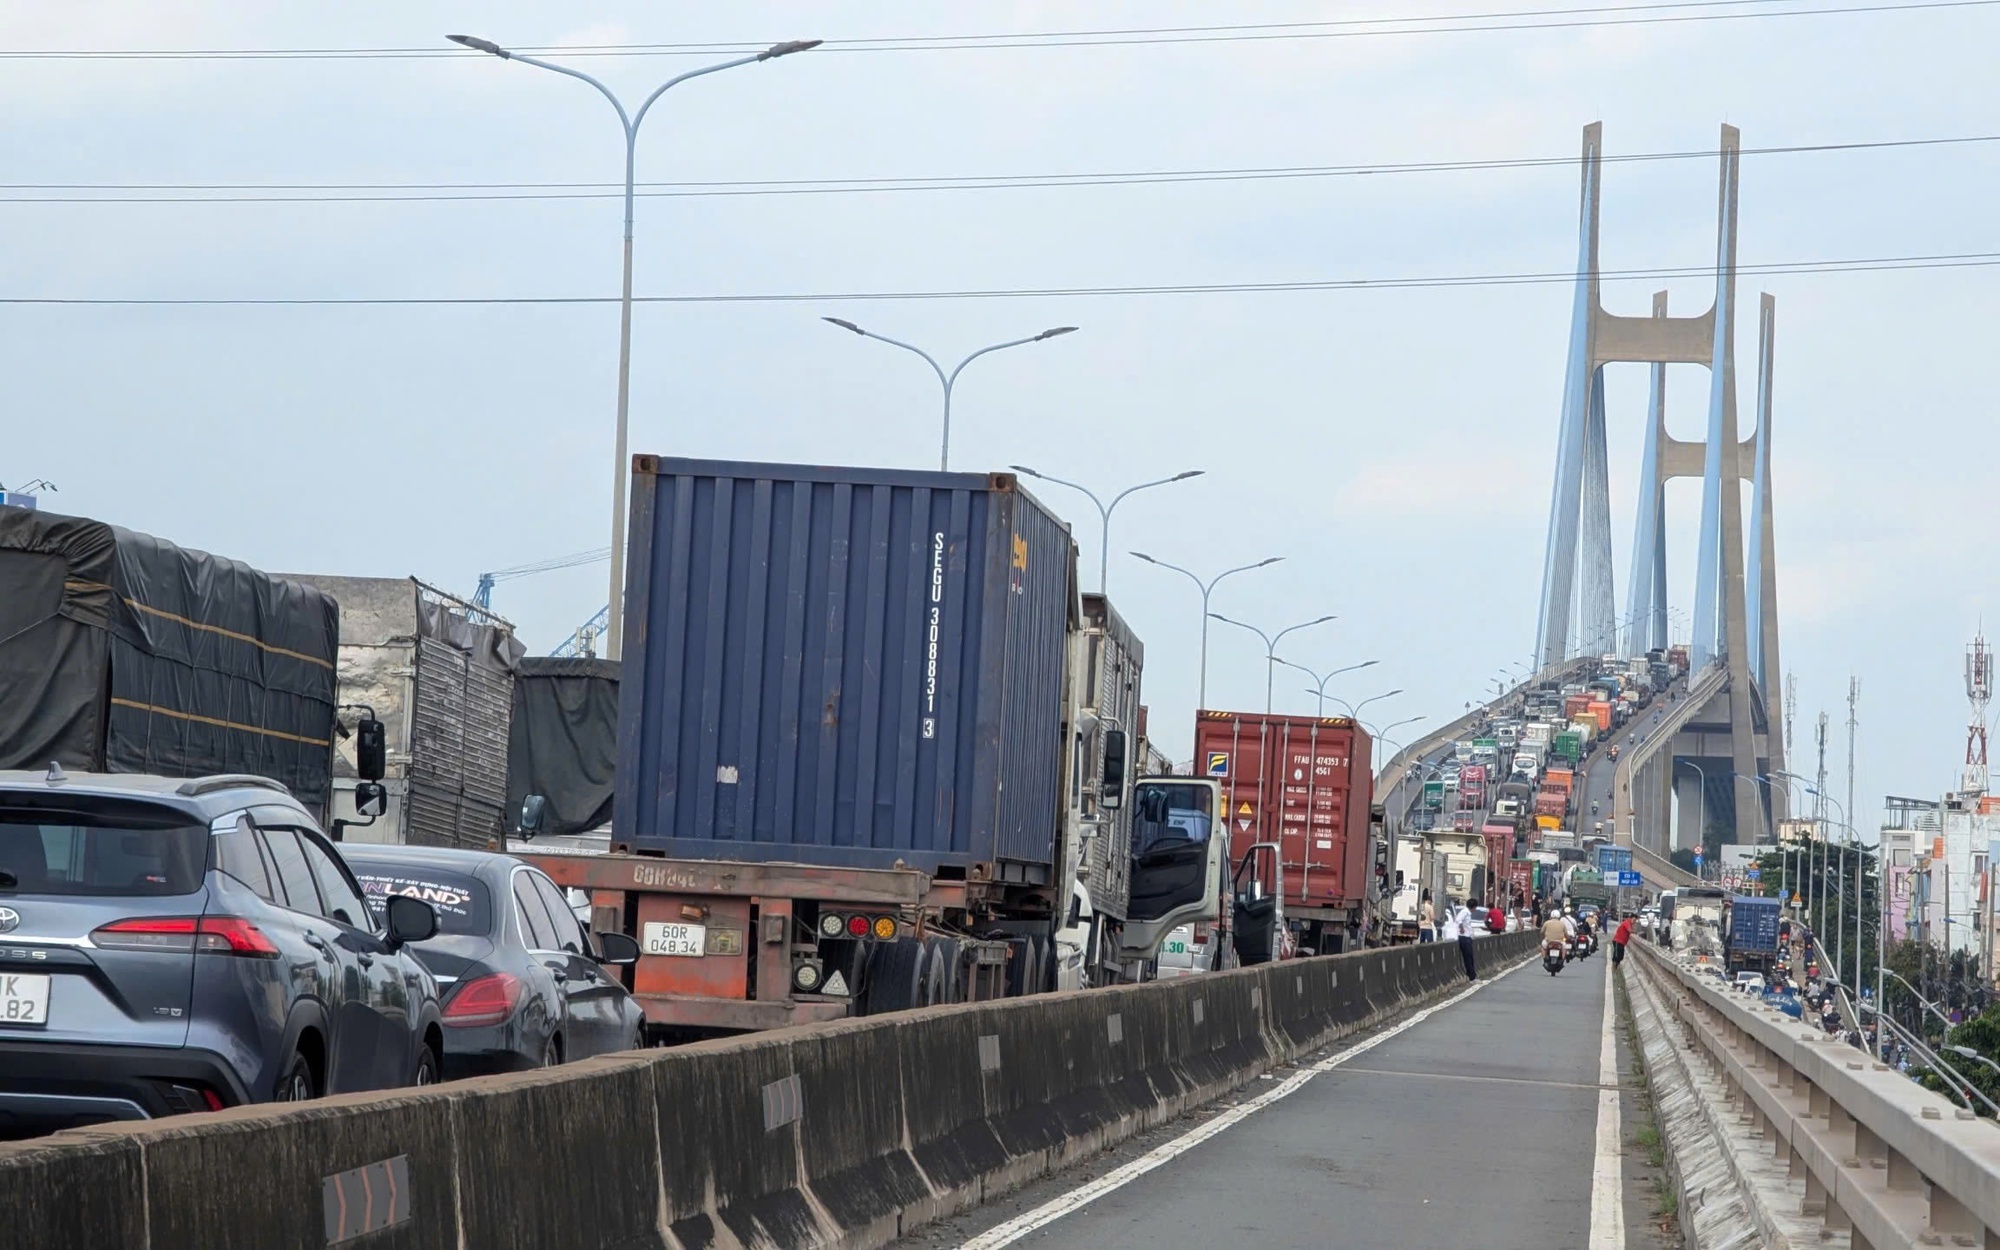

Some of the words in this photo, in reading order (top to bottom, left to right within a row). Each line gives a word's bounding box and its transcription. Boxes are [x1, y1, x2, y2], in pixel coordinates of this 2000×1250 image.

[931, 532, 945, 603] SEGU
[926, 607, 940, 713] 308831
[923, 718, 934, 738] 3
[1294, 755, 1310, 765] FFAU
[1315, 757, 1339, 766] 474353
[1315, 767, 1331, 776] 45G1
[661, 925, 688, 939] 60R
[650, 939, 697, 953] 048.34
